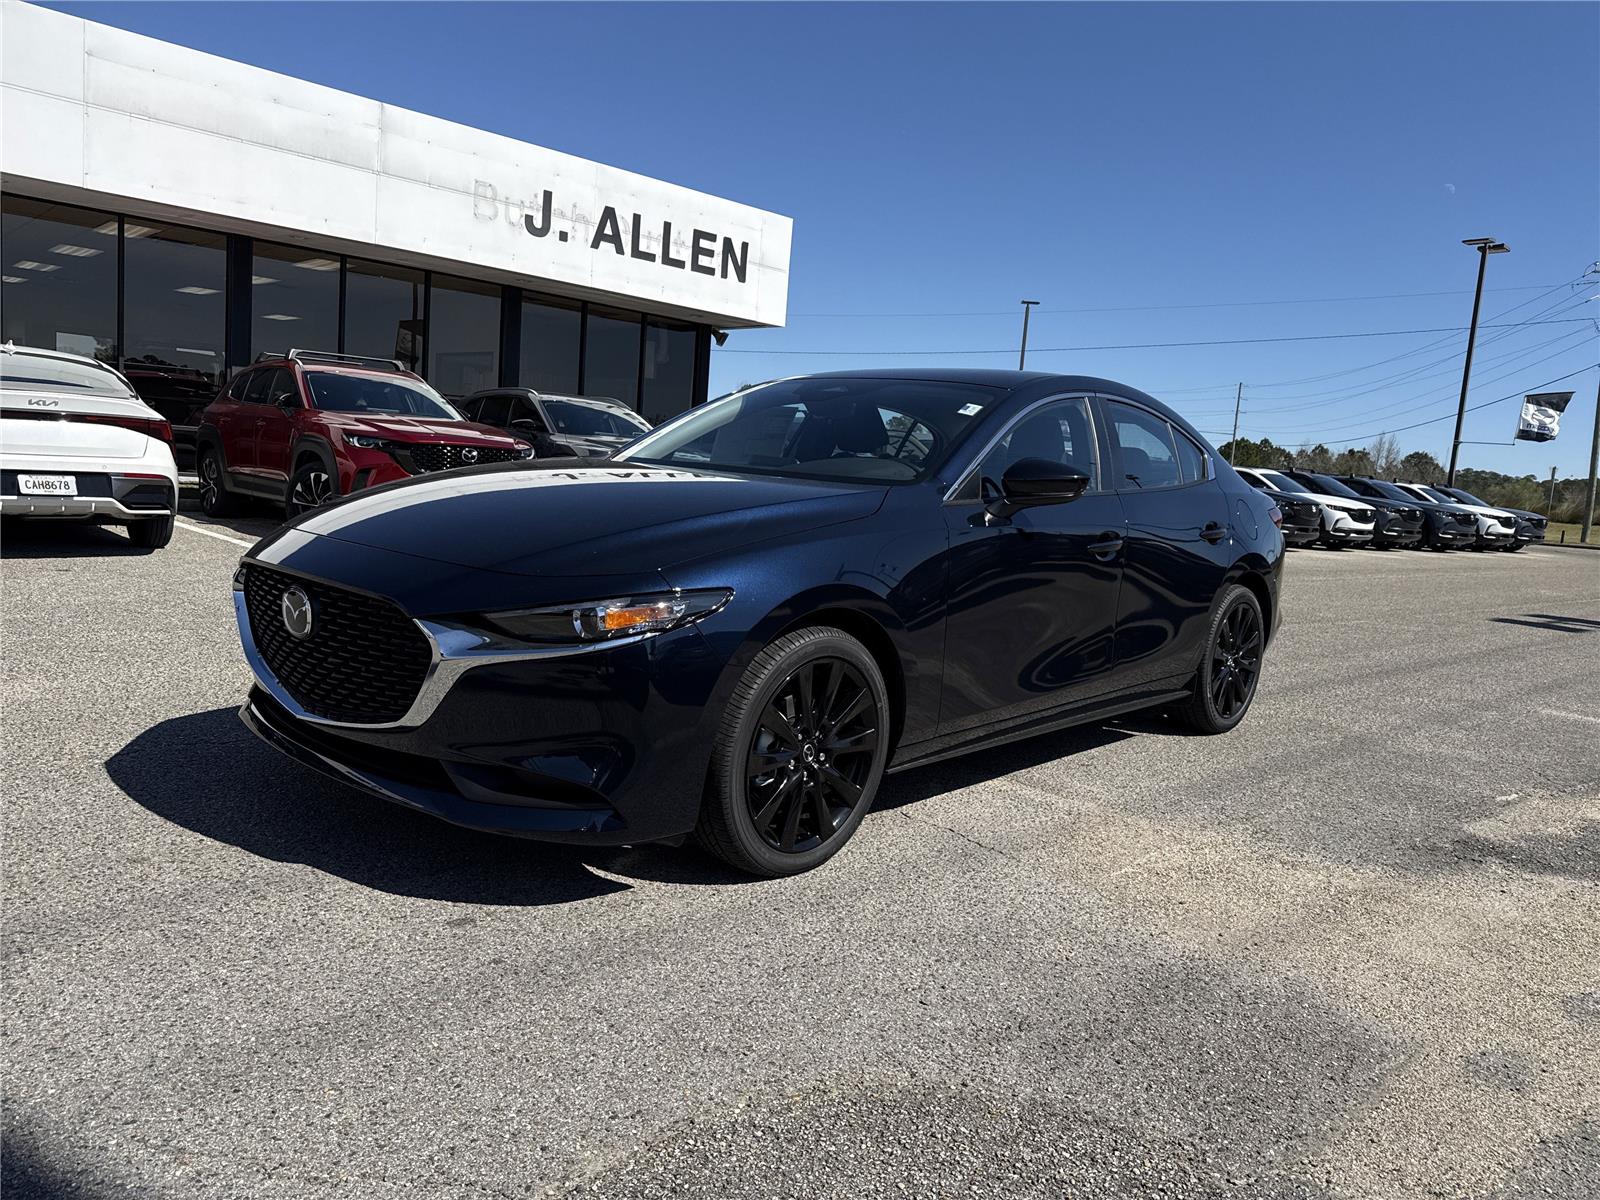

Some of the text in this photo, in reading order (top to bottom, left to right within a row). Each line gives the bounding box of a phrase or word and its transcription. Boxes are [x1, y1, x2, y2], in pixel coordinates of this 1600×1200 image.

[525, 189, 569, 242] J.
[590, 205, 749, 284] ALLEN
[24, 479, 70, 490] CAH8678
